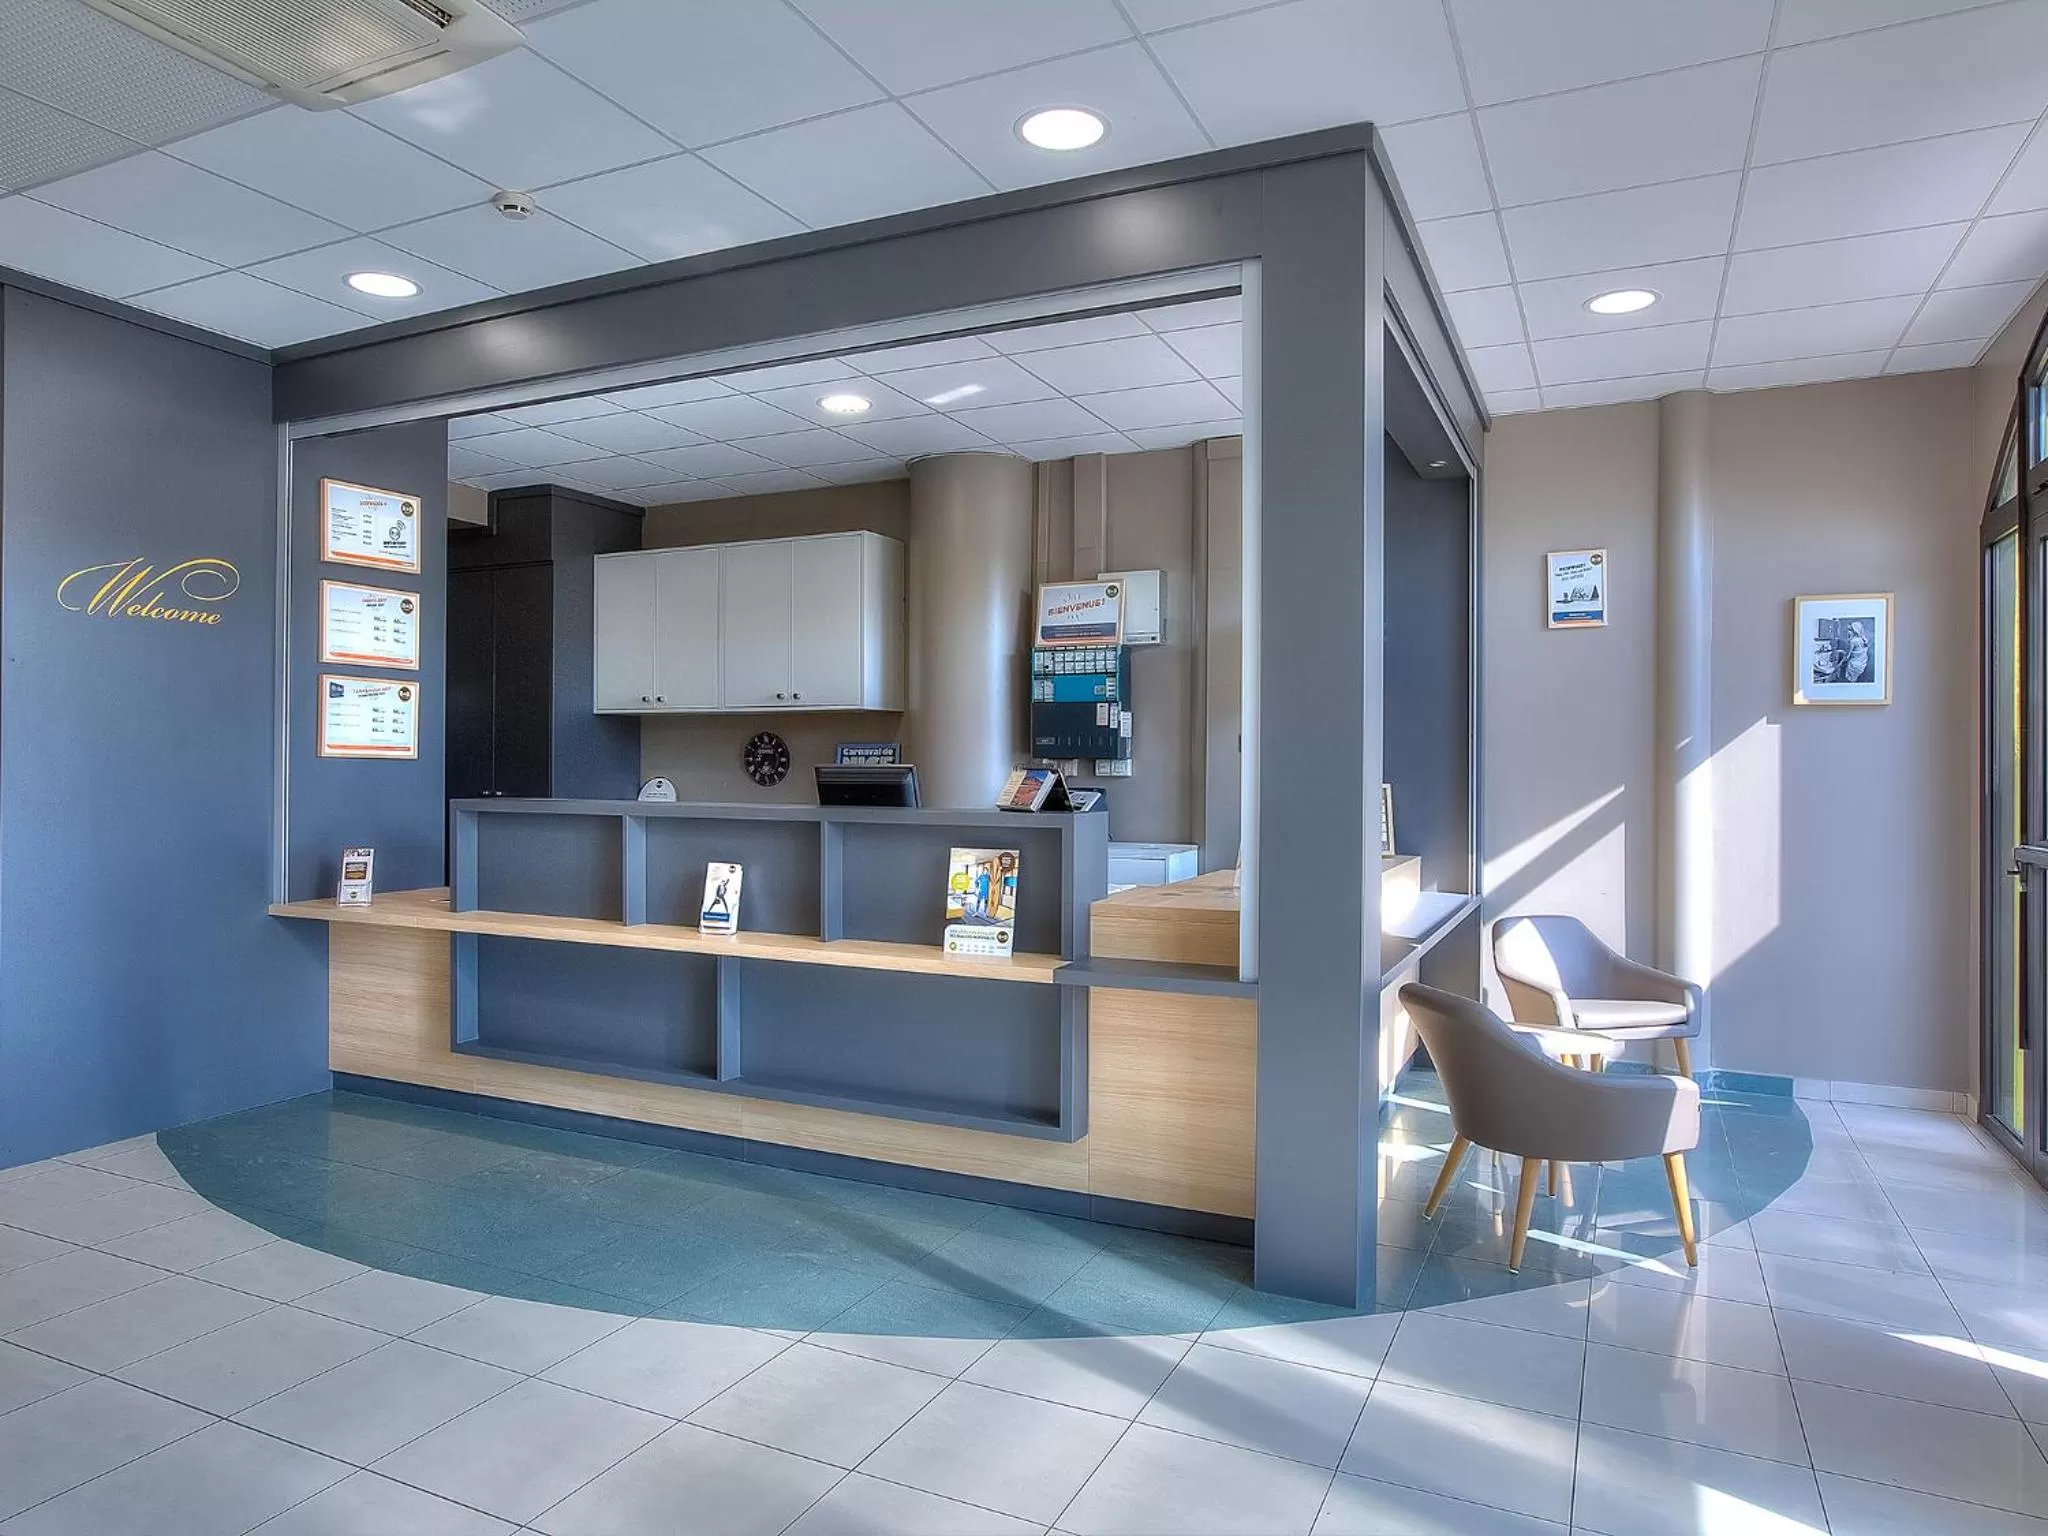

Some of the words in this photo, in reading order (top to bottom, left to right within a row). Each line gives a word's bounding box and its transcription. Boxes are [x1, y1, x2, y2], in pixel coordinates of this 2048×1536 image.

[57, 556, 240, 625] Welcome
[843, 748, 881, 756] Carnaval
[882, 748, 894, 756] de
